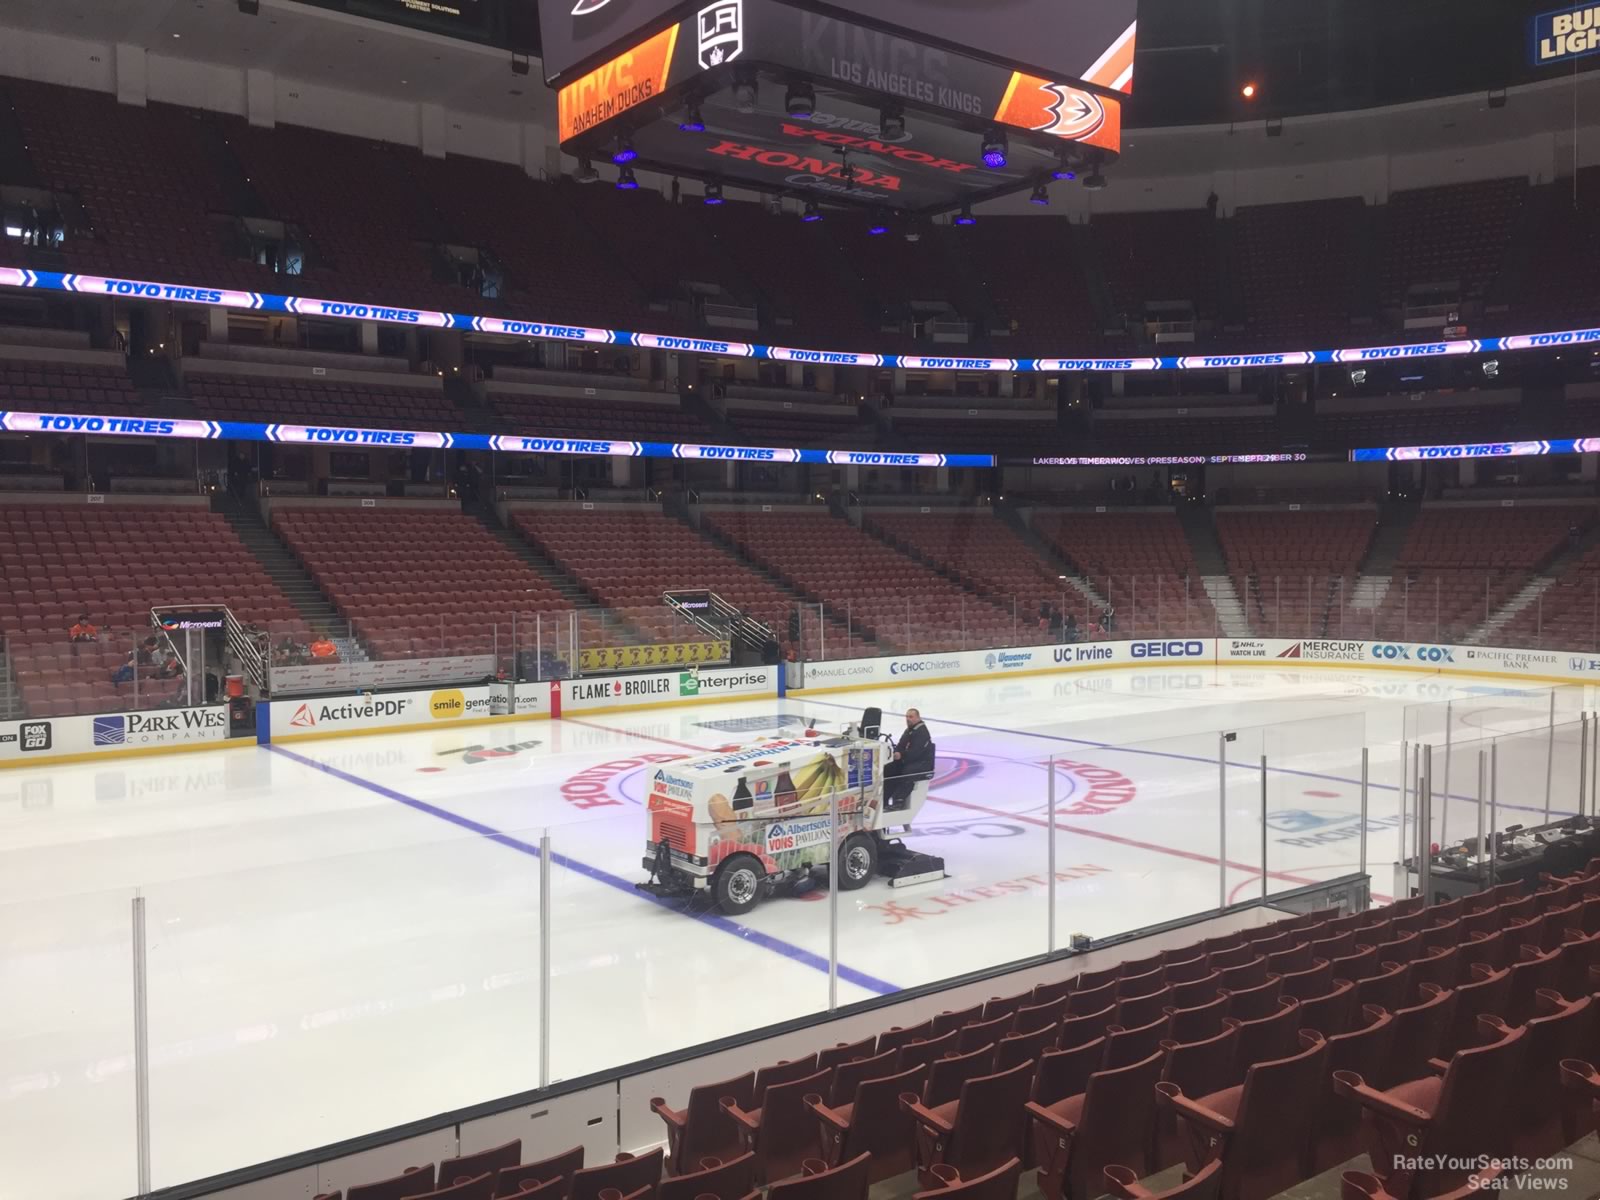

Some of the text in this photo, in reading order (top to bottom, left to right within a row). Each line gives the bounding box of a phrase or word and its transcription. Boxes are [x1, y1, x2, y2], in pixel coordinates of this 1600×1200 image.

[701, 7, 737, 39] LA
[831, 57, 982, 115] LOS ANGELES KINGS
[572, 78, 652, 134] ANAHEIM DUCKS
[781, 123, 979, 173] HONDA
[707, 140, 901, 191] HONDA
[104, 279, 222, 303] TOYO TIRES
[320, 301, 419, 322] TOYO TIRES
[502, 321, 586, 339] TOYO TIRES
[656, 336, 728, 352] TOYO TIRES
[1529, 332, 1573, 346] TOYO
[789, 350, 858, 364] TOYO TIRES
[1360, 344, 1447, 359] TOYO TIRES
[920, 357, 991, 369] TOYO TIRES
[1058, 360, 1133, 369] TOYO TIRES
[1203, 354, 1284, 367] TOYO TIRES
[39, 415, 175, 434] TOYO TIRES
[305, 428, 415, 445] TOYO TIRES
[521, 438, 610, 453] TOYO TIRES
[699, 446, 774, 459] TOYO TIRES
[1418, 444, 1512, 458] TOYO TIRES
[848, 453, 919, 465] TOYO TIRES
[1147, 456, 1206, 465] (PRESEASON)
[1294, 453, 1307, 461] 30
[681, 601, 709, 609] Microsemi
[179, 619, 222, 629] Microsemi
[1053, 645, 1113, 663] UC Irvine
[1131, 641, 1203, 658] GEICO
[1302, 641, 1364, 653] MERCURY
[1372, 644, 1411, 660] COX
[998, 652, 1032, 663] Wawanesa
[1302, 651, 1365, 661] INSURANCE
[1417, 647, 1455, 663] COX
[1477, 651, 1558, 664] PACIFIC PREMIER
[817, 668, 846, 677] MANUEL
[847, 666, 874, 675] CASINO
[900, 661, 925, 673] CHOC
[1002, 660, 1025, 669] Insurance
[1503, 661, 1529, 669] BANK
[682, 672, 767, 691] enterprise
[572, 678, 670, 701] FLAME BROILER
[433, 698, 461, 710] smile
[25, 725, 46, 735] FOX
[126, 714, 181, 734] PARK
[25, 738, 46, 748] GO
[560, 752, 692, 810] HONDA
[665, 774, 695, 790] Albertsons
[1034, 759, 1137, 815] HONDA
[768, 836, 793, 851] VONS
[1059, 1137, 1066, 1149] E
[1210, 1136, 1217, 1148] F
[1407, 1134, 1418, 1147] G
